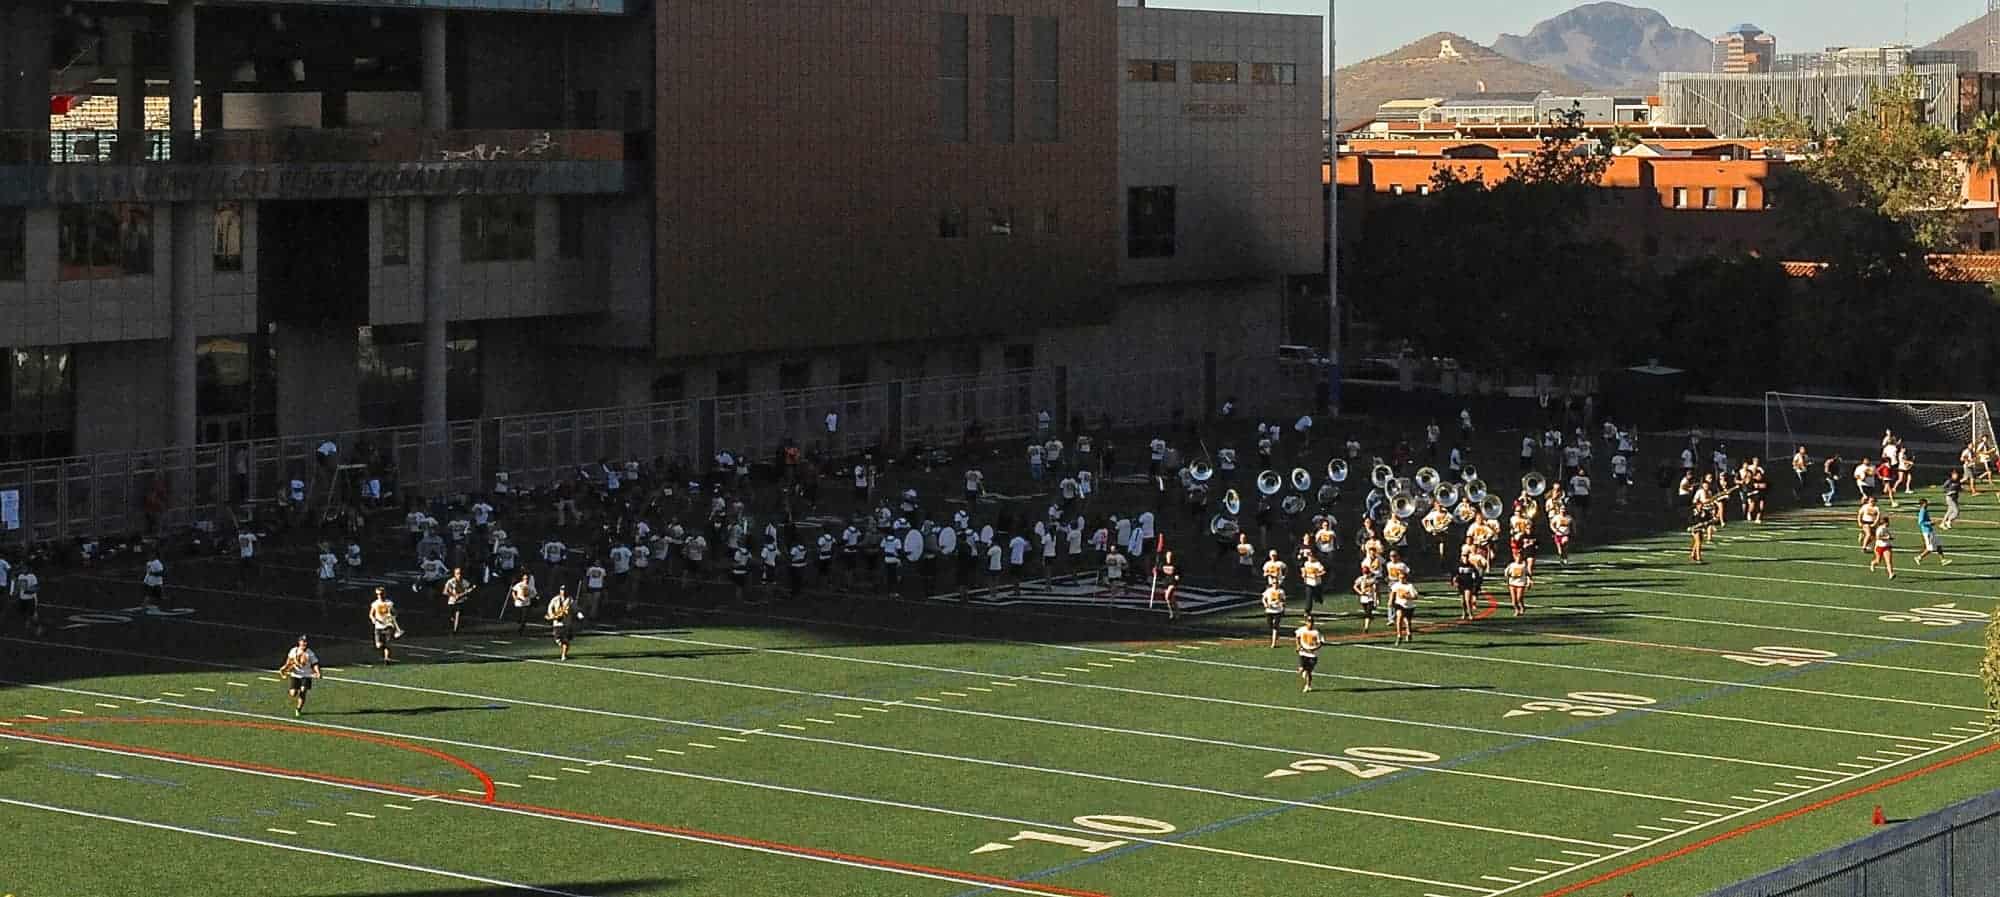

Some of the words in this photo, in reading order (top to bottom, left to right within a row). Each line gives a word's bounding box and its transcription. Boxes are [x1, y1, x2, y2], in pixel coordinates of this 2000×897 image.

[1720, 645, 1838, 667] 40
[1521, 691, 1657, 717] 30
[1289, 746, 1441, 779] 20
[1007, 814, 1177, 853] 10
